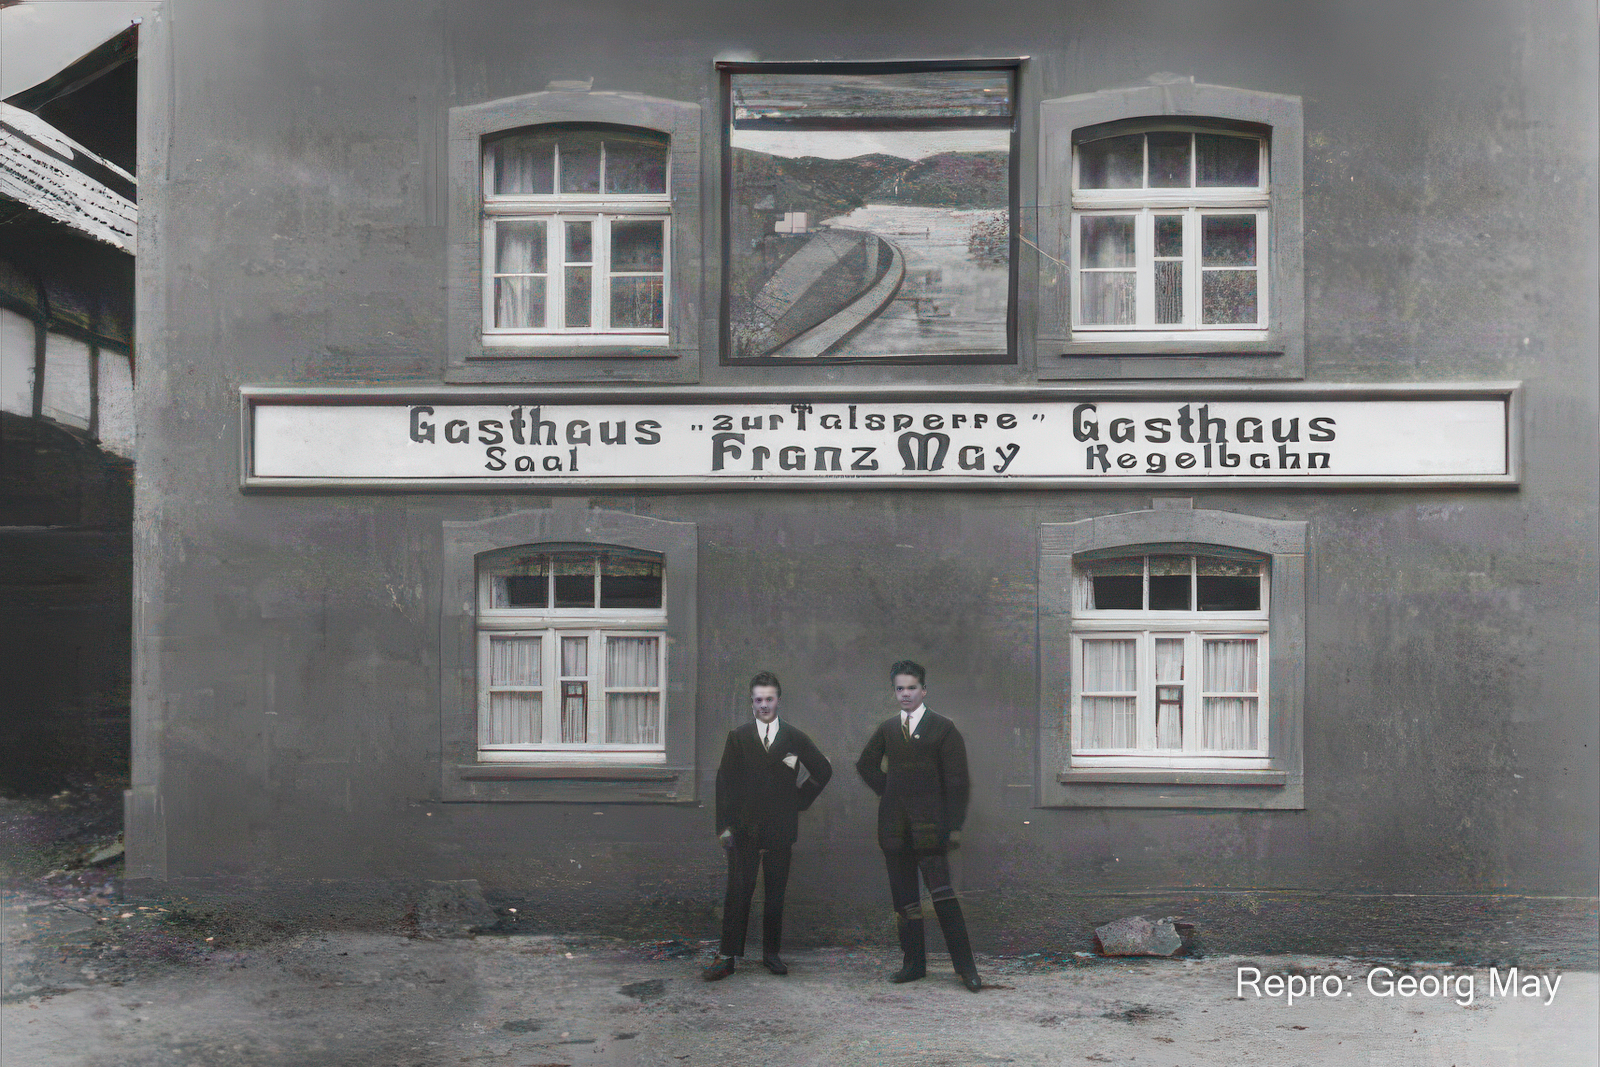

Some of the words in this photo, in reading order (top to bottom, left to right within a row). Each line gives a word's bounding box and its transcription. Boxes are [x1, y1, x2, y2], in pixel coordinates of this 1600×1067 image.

[409, 405, 662, 446] Gasthaus
[1072, 404, 1336, 444] Gasthaus
[484, 446, 579, 472] Saal
[711, 432, 879, 472] Franz
[897, 431, 1021, 474] May
[1086, 443, 1331, 474] Kegelbahn
